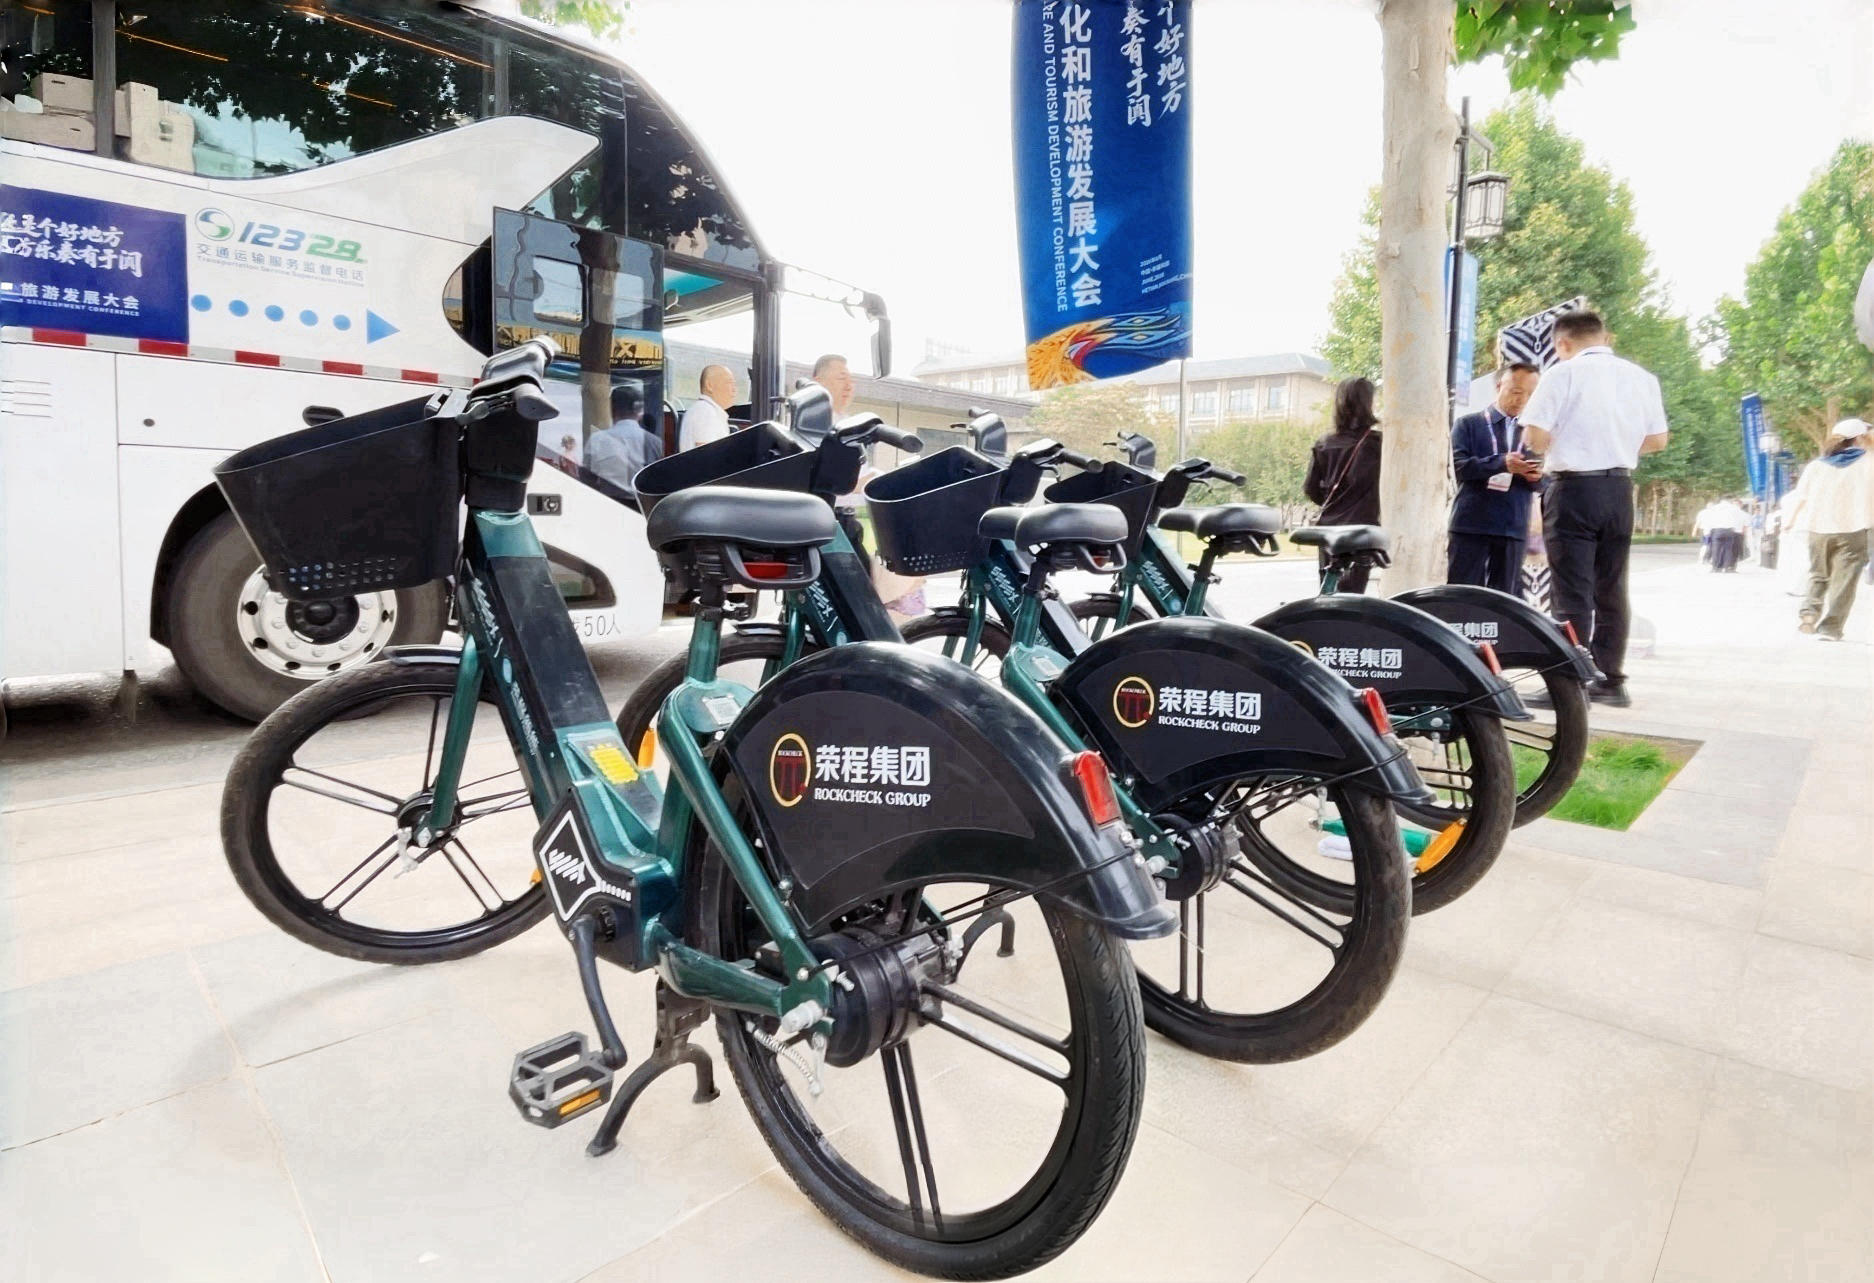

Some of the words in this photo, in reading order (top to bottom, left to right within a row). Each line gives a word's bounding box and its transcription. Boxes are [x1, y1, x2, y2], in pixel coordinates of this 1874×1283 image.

[1043, 24, 1055, 53] AND
[1044, 57, 1059, 122] TOURISM
[1059, 4, 1102, 309] 化和旅游发展大会
[1047, 126, 1063, 224] DEVELOPMENT
[238, 221, 368, 264] 12328
[197, 243, 364, 281] 交通运输服务监督电话
[197, 255, 259, 270] Transportation
[261, 266, 290, 276] Service
[291, 270, 337, 284] Supervision
[338, 279, 365, 288] Hotline
[1052, 227, 1068, 313] CONFERENCE
[20, 282, 140, 310] 旅游发展大会
[26, 298, 86, 311] DEVELOPMENT
[88, 306, 140, 317] CONFERENCE
[1318, 646, 1402, 669] 荣程集团
[1370, 670, 1402, 679] GROUP
[1158, 686, 1262, 720] 荣程集团
[1158, 715, 1220, 731] ROCKCHECK
[1221, 721, 1261, 735] GROUP
[815, 744, 931, 786] 荣程集团
[814, 787, 883, 804] ROCKCHECK
[885, 791, 931, 807] GROUP
